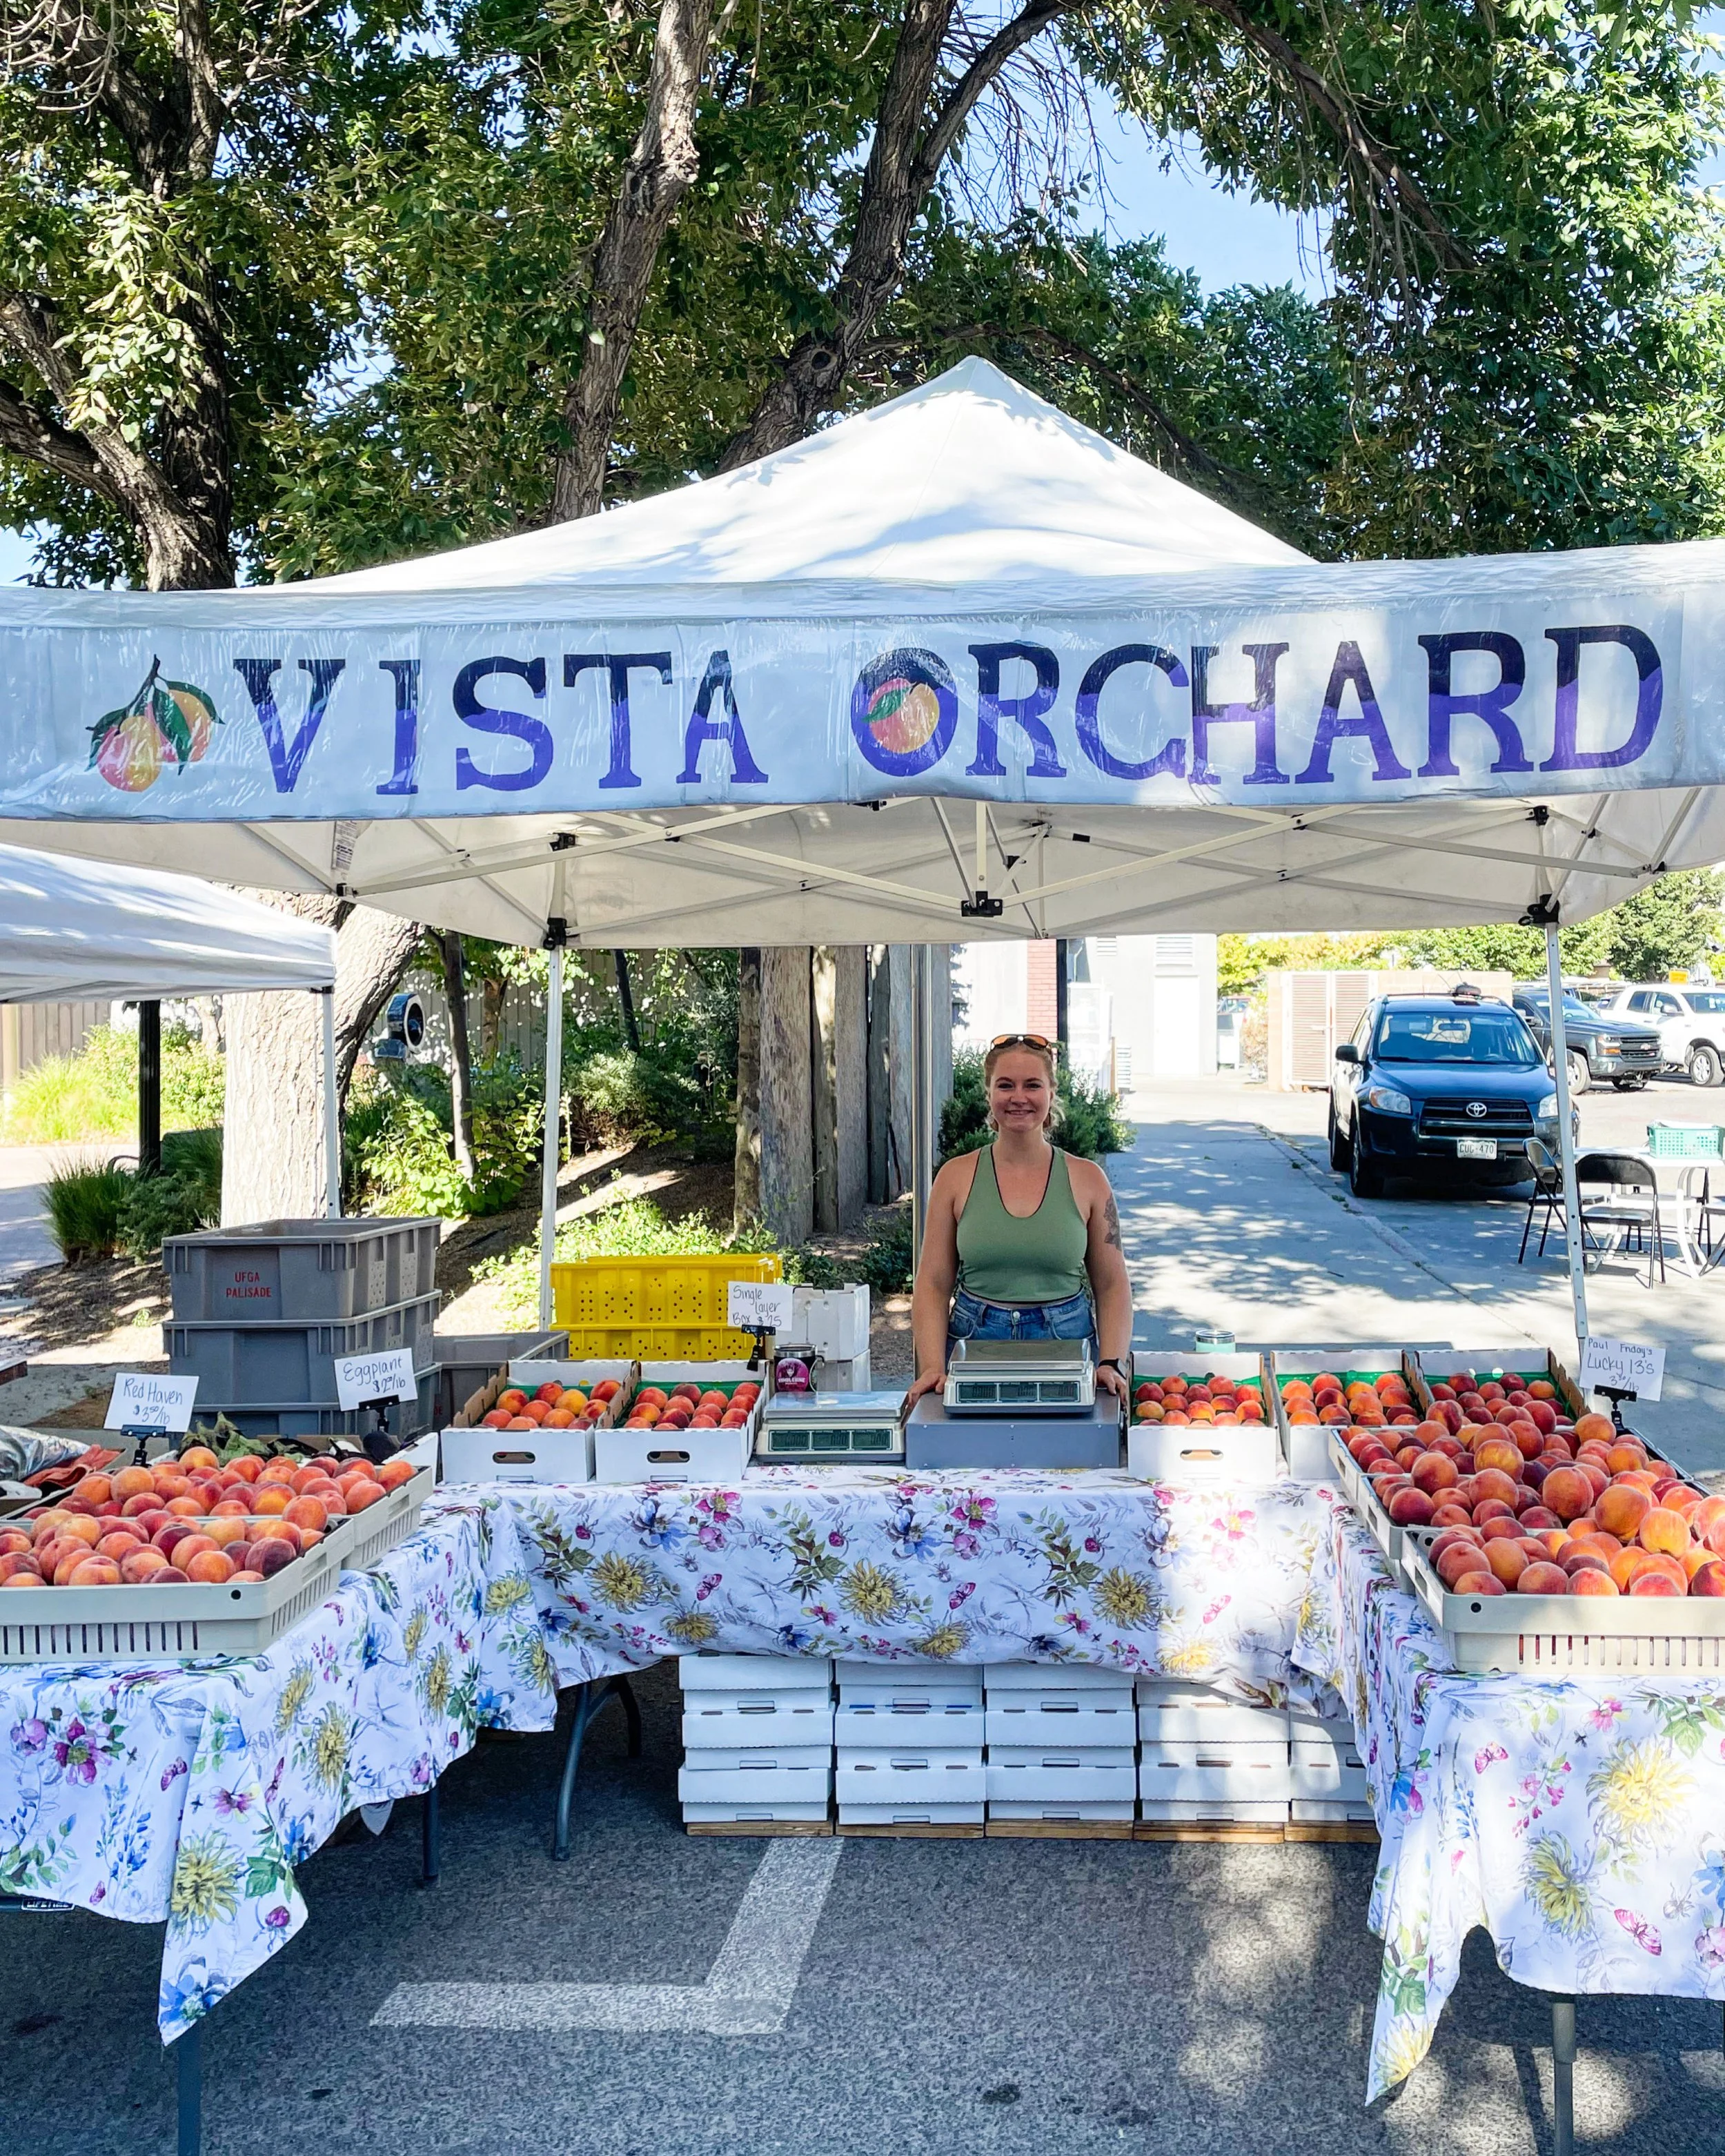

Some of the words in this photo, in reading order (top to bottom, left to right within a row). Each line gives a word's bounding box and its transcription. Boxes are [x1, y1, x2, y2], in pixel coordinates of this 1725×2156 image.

[233, 649, 769, 795] VISTA
[850, 624, 1664, 785] ORCHARD
[235, 1271, 259, 1283] UFGA
[226, 1287, 272, 1298] PALISADE
[733, 1285, 762, 1305] Single
[733, 1312, 751, 1325] Box
[1588, 1338, 1608, 1349] Paul
[343, 1356, 403, 1386] Eggplant
[1587, 1353, 1624, 1377] Lucky
[1630, 1358, 1655, 1375] 13's
[123, 1378, 145, 1398] Red
[147, 1381, 184, 1405] Haven
